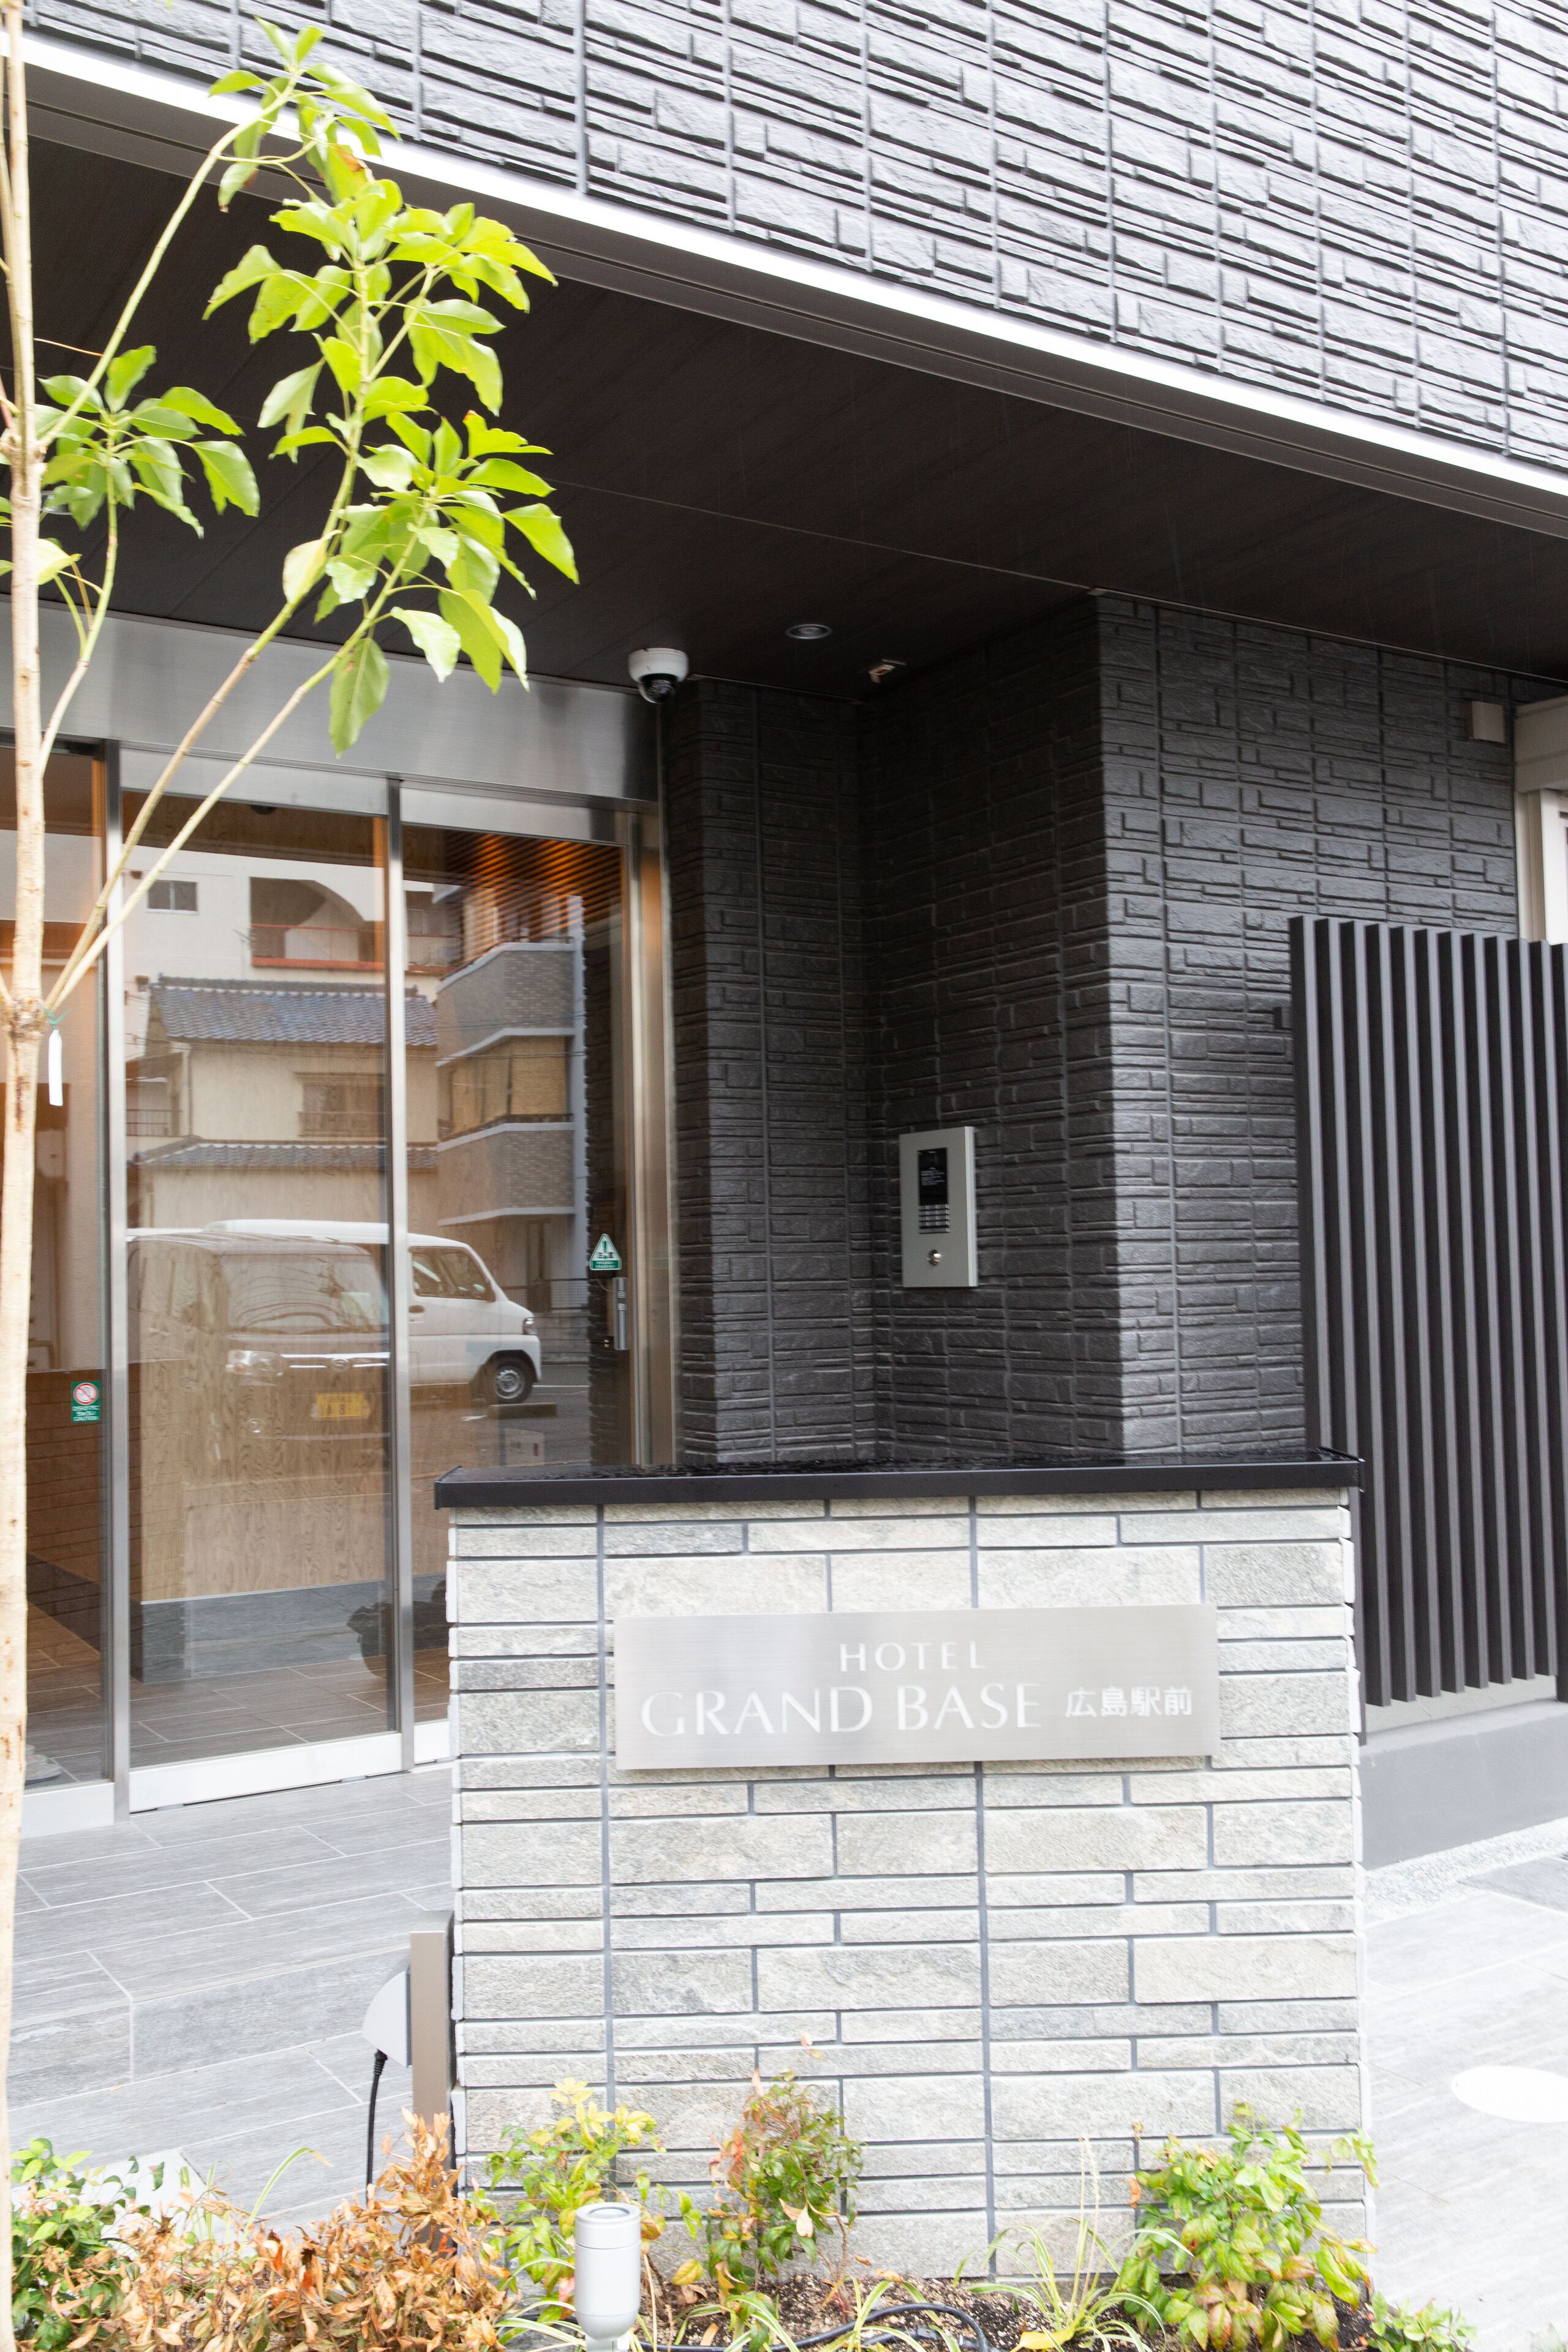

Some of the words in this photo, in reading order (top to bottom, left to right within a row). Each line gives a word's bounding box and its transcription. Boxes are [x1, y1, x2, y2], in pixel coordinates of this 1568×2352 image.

[839, 1641, 986, 1672] HOTEL
[641, 1685, 872, 1735] GRAND
[897, 1683, 1041, 1730] BASE
[1065, 1686, 1194, 1717] 広島駅前
